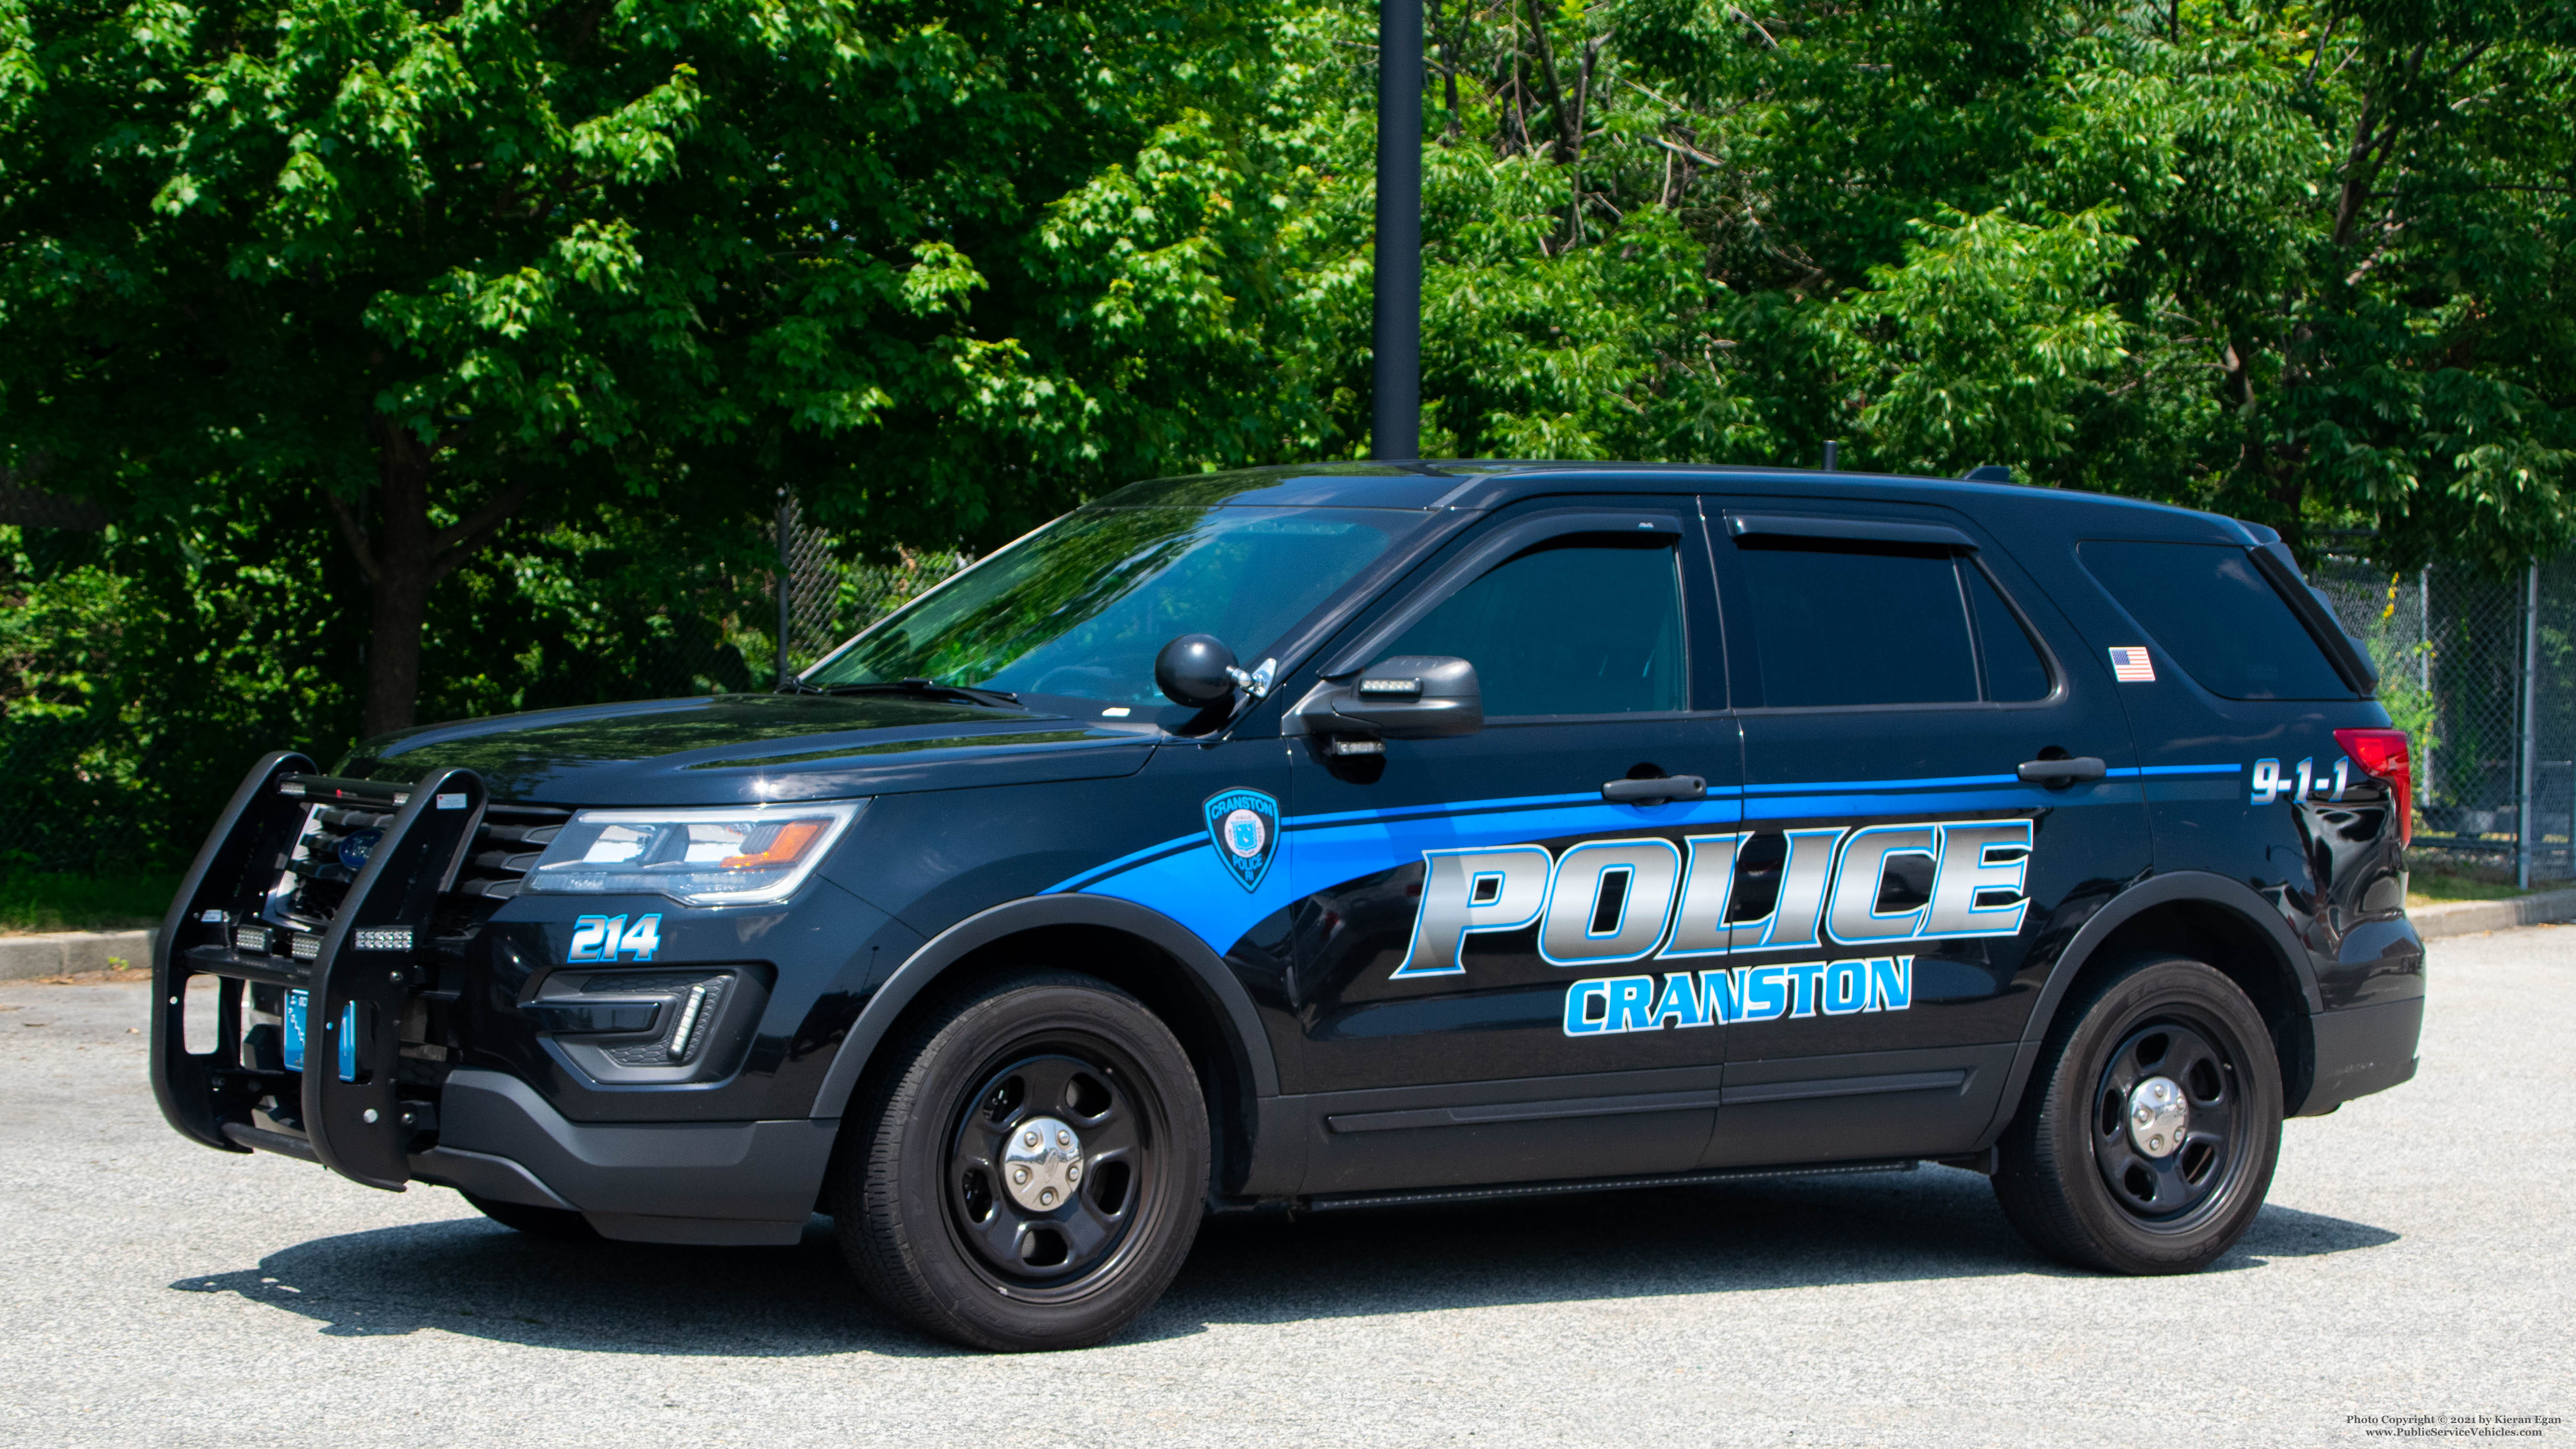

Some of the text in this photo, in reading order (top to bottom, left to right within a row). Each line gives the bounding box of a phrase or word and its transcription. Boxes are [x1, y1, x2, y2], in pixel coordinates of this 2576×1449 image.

[2251, 755, 2349, 806] 9-1-1
[1211, 795, 1273, 820] CRANSTON
[1232, 852, 1263, 871] POLICE
[1245, 870, 1254, 881] RI
[1388, 819, 2033, 980] POLICE
[566, 912, 663, 964] 214
[1563, 954, 1915, 1037] CRANSTON
